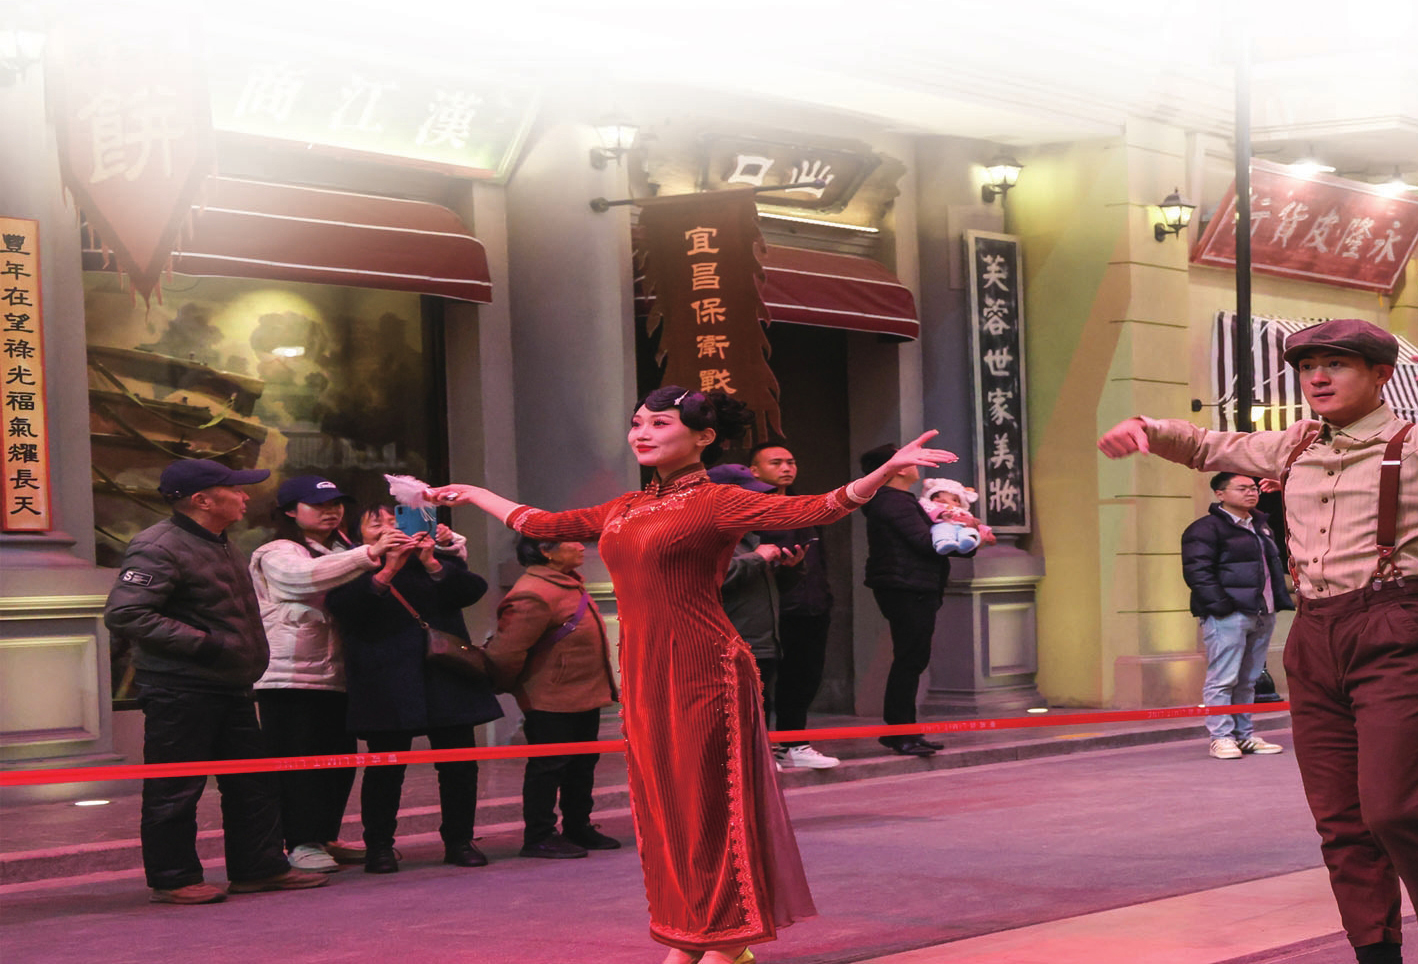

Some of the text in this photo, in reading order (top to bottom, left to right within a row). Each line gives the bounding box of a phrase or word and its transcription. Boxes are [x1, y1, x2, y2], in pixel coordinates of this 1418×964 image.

[684, 226, 737, 395] 宜昌保衛戰
